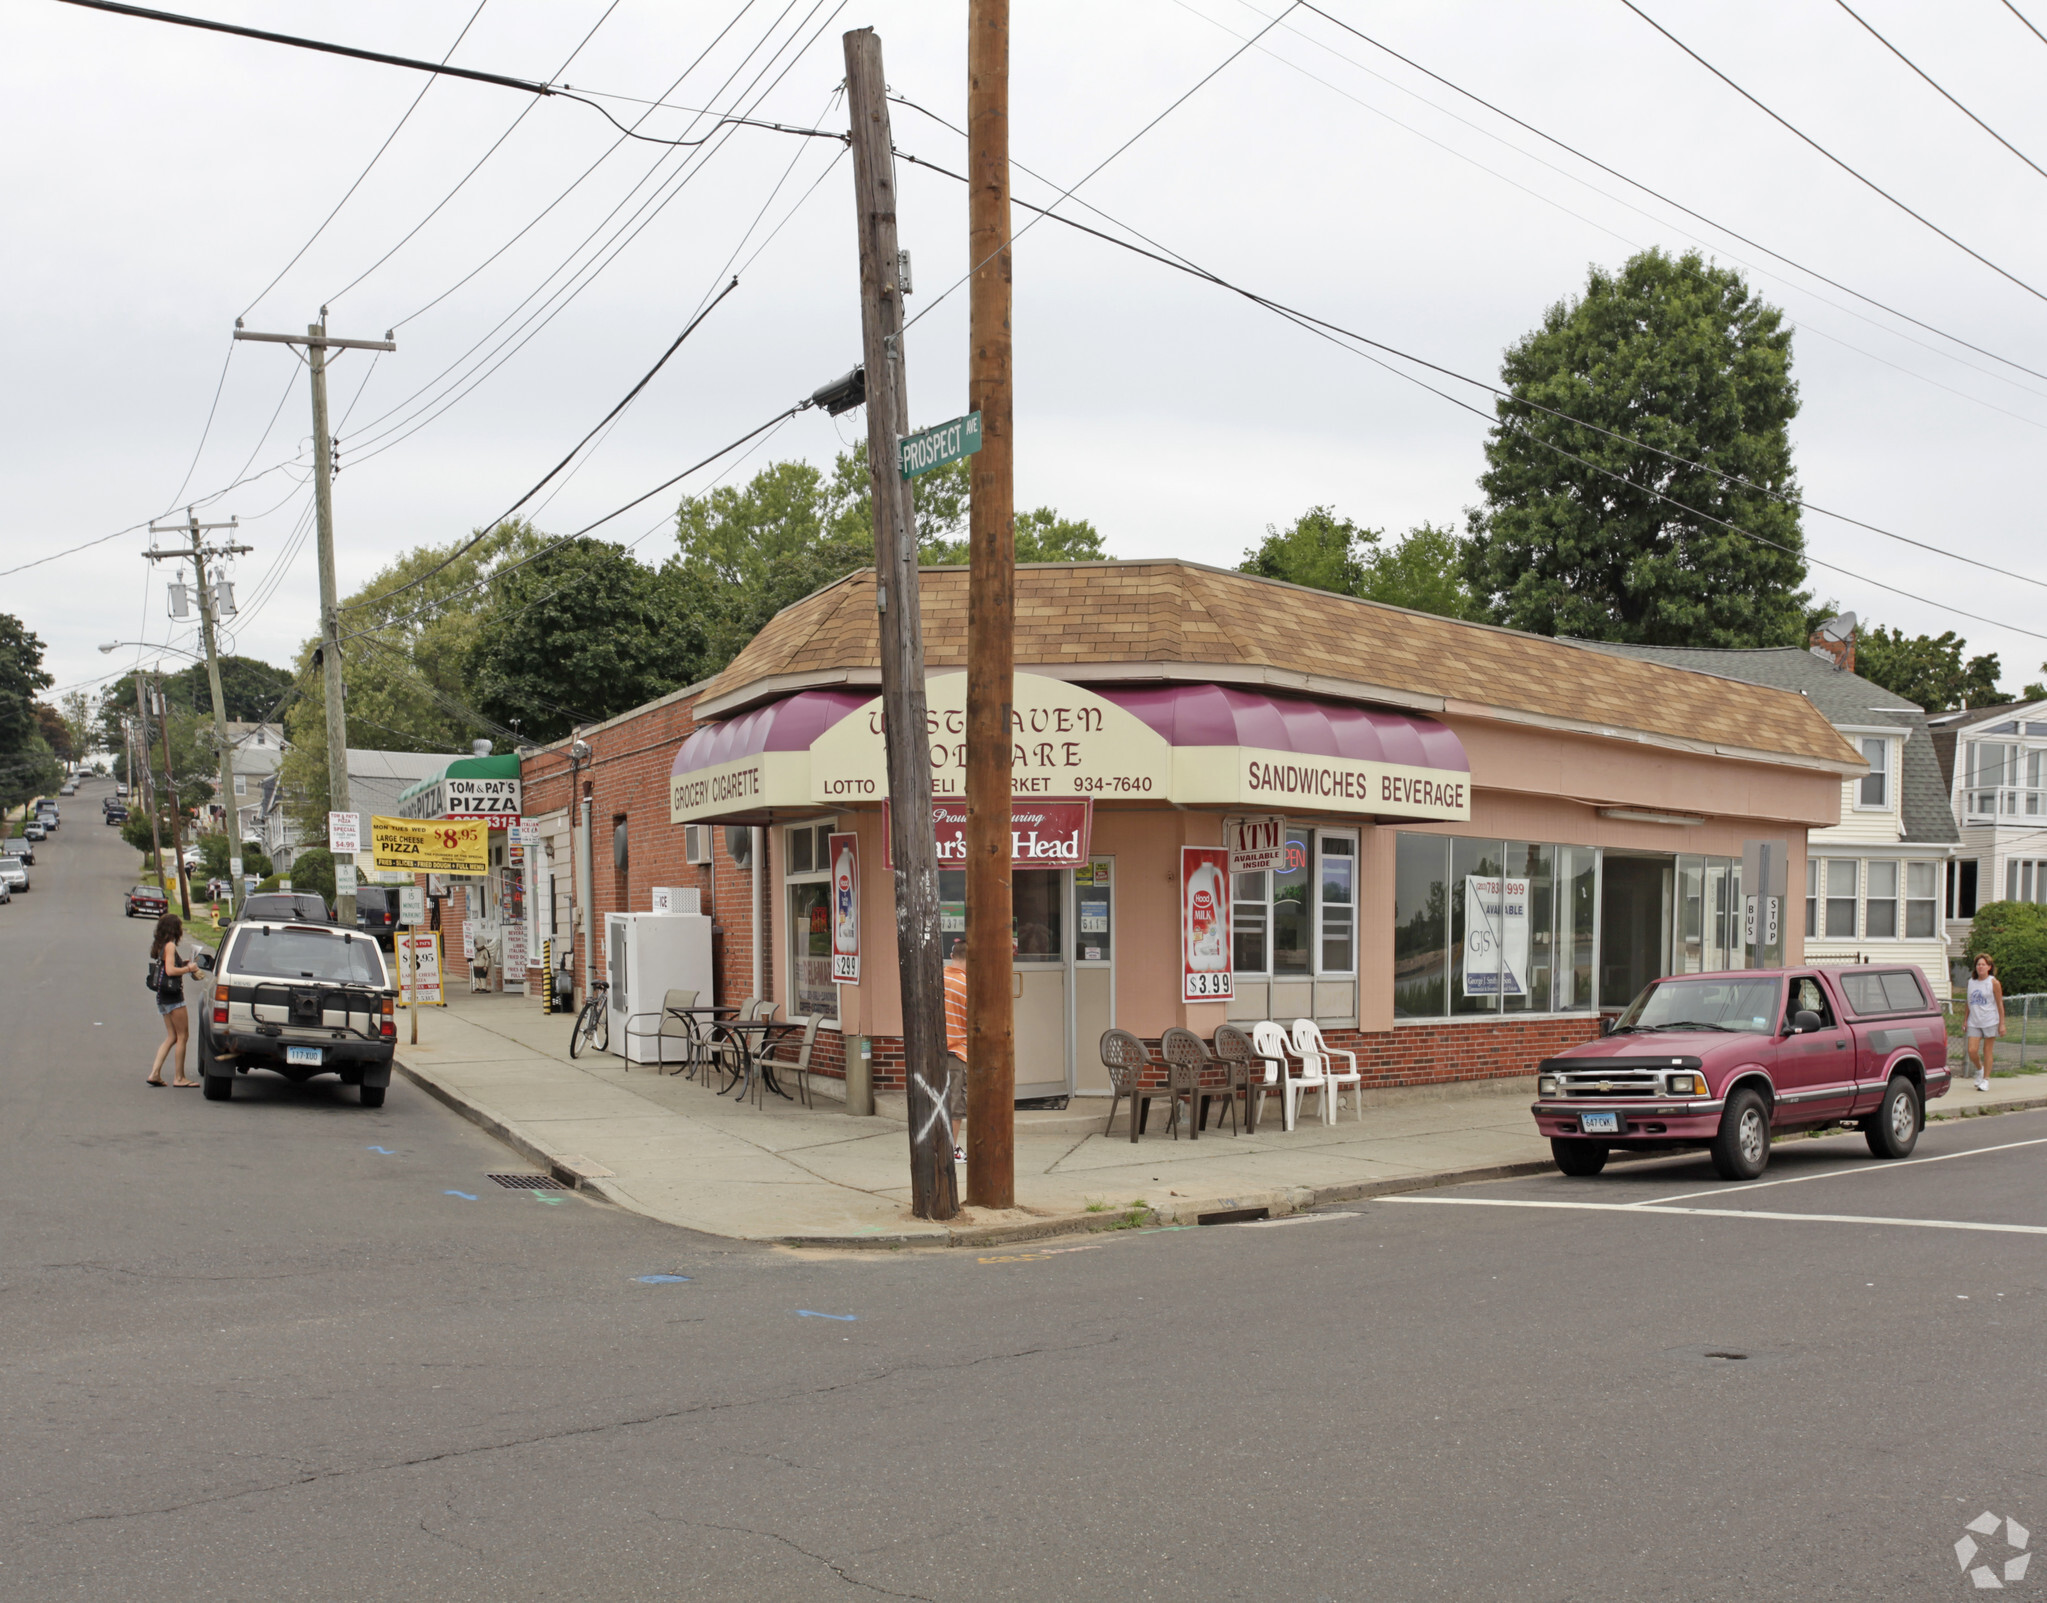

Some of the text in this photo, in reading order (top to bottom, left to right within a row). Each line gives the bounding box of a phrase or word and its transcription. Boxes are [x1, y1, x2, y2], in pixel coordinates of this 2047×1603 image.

[903, 417, 978, 473] PROSPECT AVE
[1012, 707, 1103, 733] AVEN
[1011, 742, 1082, 767] ARE
[449, 781, 475, 794] TOM
[485, 781, 516, 794] PAT'S
[674, 767, 759, 811] GROCERY CIGARETTE
[824, 777, 1152, 794] LOTTO ELI RKET 934-7640
[1248, 761, 1464, 808] SANDWICHES BEVERAGE
[449, 797, 518, 812] PIZZA
[1012, 829, 1079, 859] Head
[1236, 822, 1279, 851] ATM
[381, 843, 420, 854] PIZZA
[1234, 852, 1280, 863] AVAILABLE
[1242, 860, 1271, 869] INSIDE
[1195, 895, 1210, 903] Hood
[1194, 910, 1212, 920] MILK
[1769, 900, 1777, 941] STOP
[1469, 930, 1491, 957] GJS
[1189, 974, 1230, 995] $3.99
